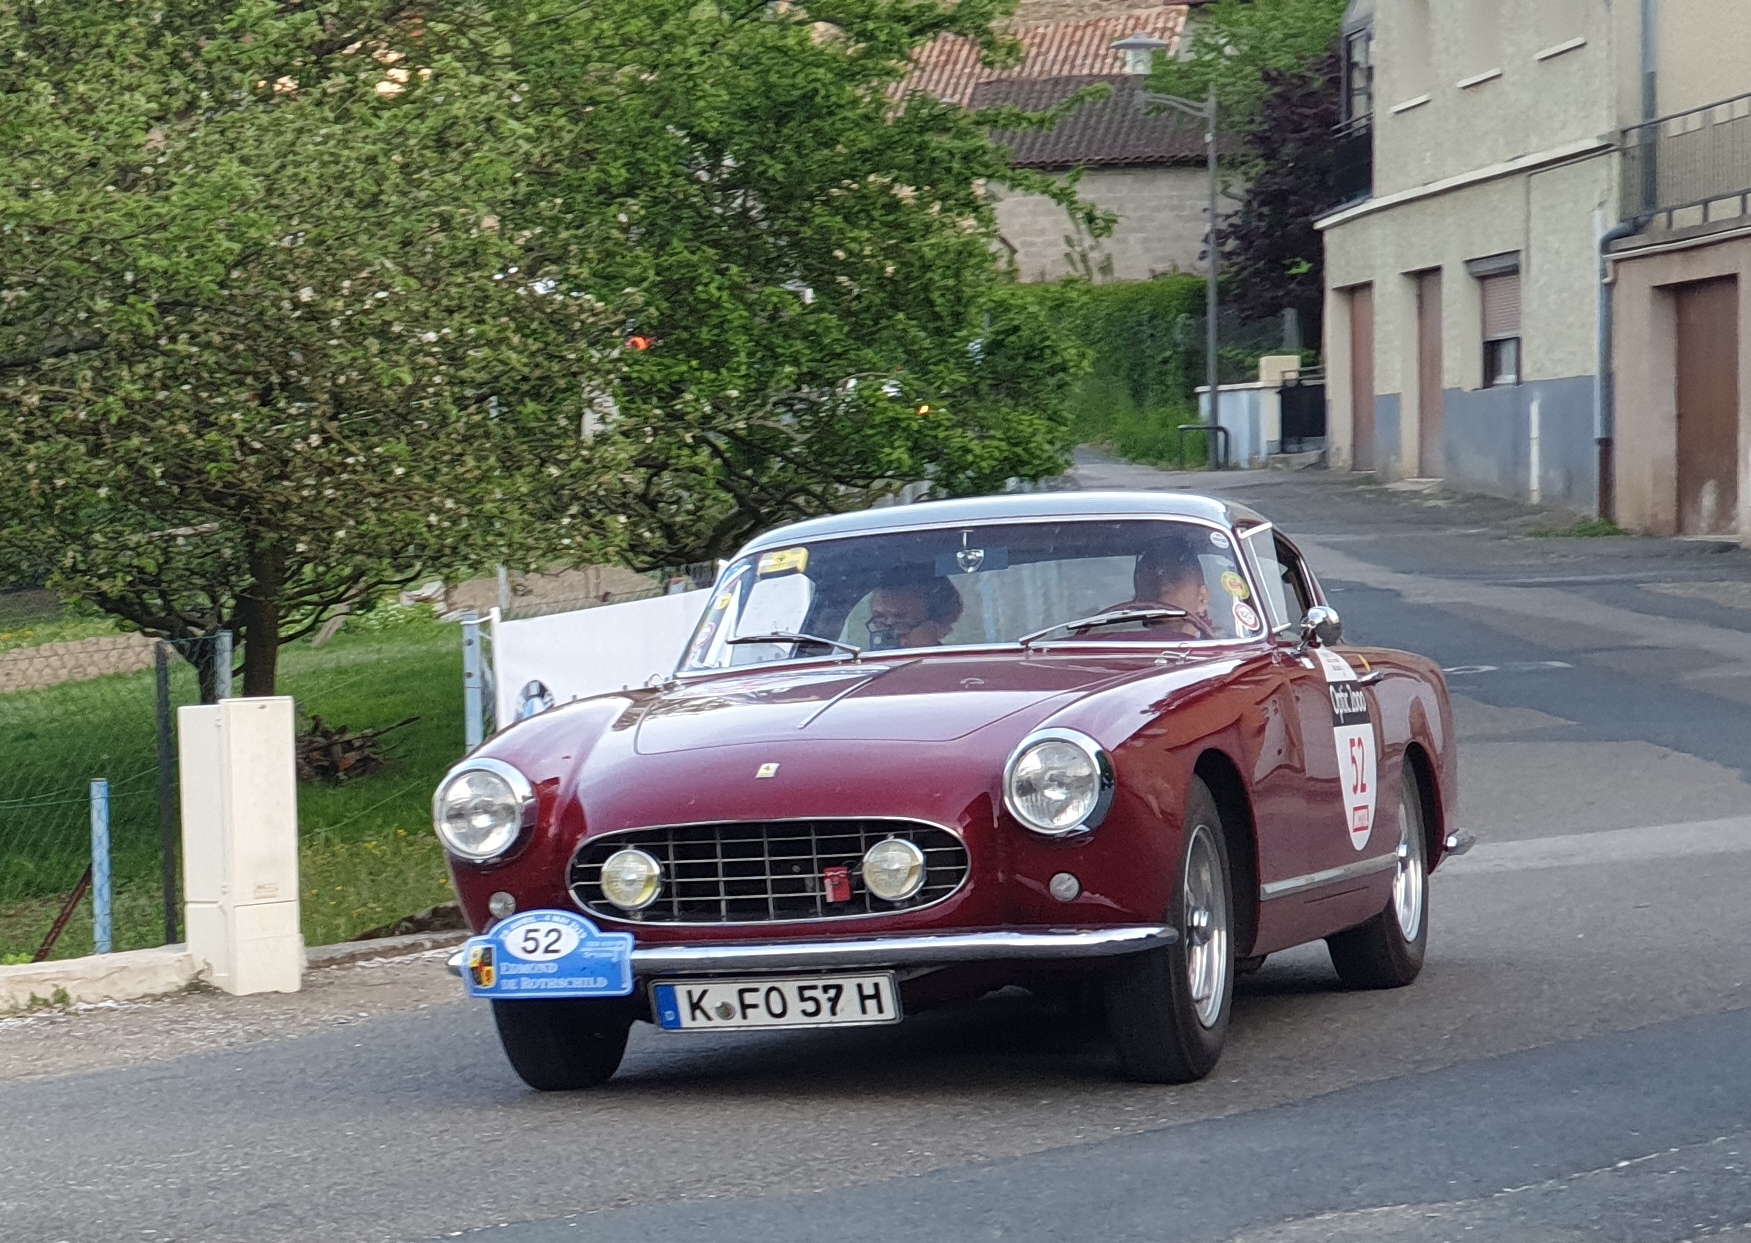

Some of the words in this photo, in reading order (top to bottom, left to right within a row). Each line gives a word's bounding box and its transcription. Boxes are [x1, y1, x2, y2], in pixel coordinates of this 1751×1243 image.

[1329, 684, 1352, 724] Optic
[1346, 684, 1367, 713] 2000
[1349, 736, 1368, 796] 52
[521, 927, 564, 955] 52
[686, 987, 713, 1022] K
[797, 983, 846, 1018] 57
[856, 981, 885, 1016] H
